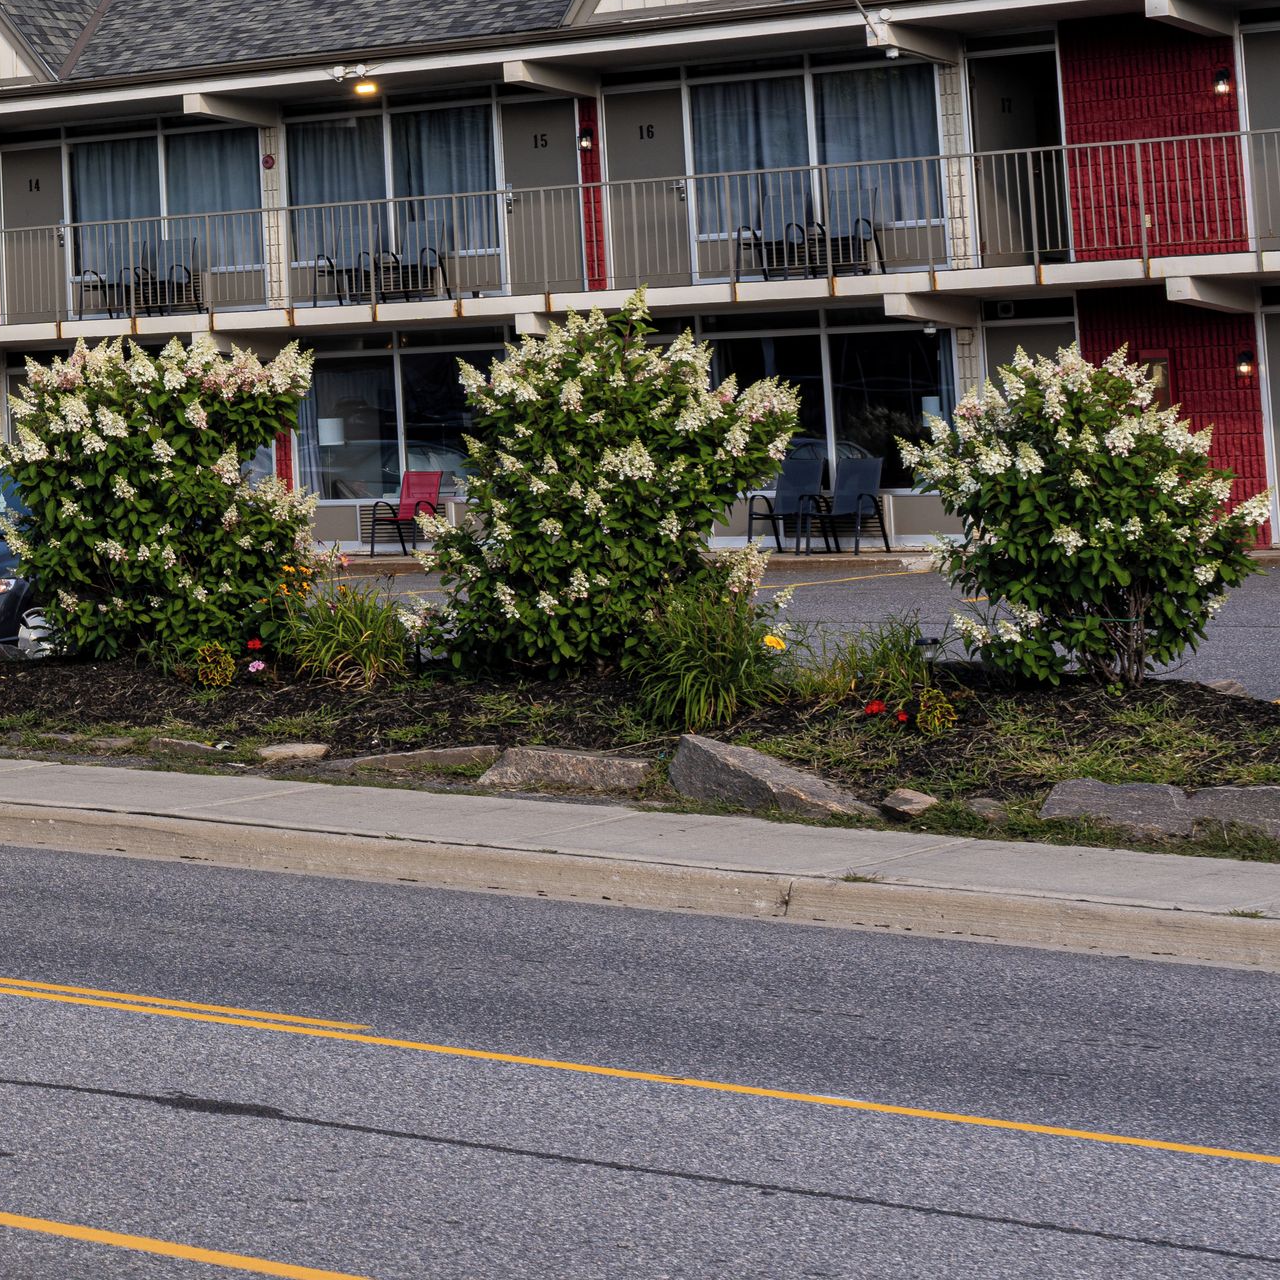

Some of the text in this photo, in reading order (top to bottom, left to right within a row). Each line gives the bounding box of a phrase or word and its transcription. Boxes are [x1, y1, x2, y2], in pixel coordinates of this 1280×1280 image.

[639, 124, 655, 140] 16
[533, 134, 548, 149] 15
[28, 178, 41, 192] 14
